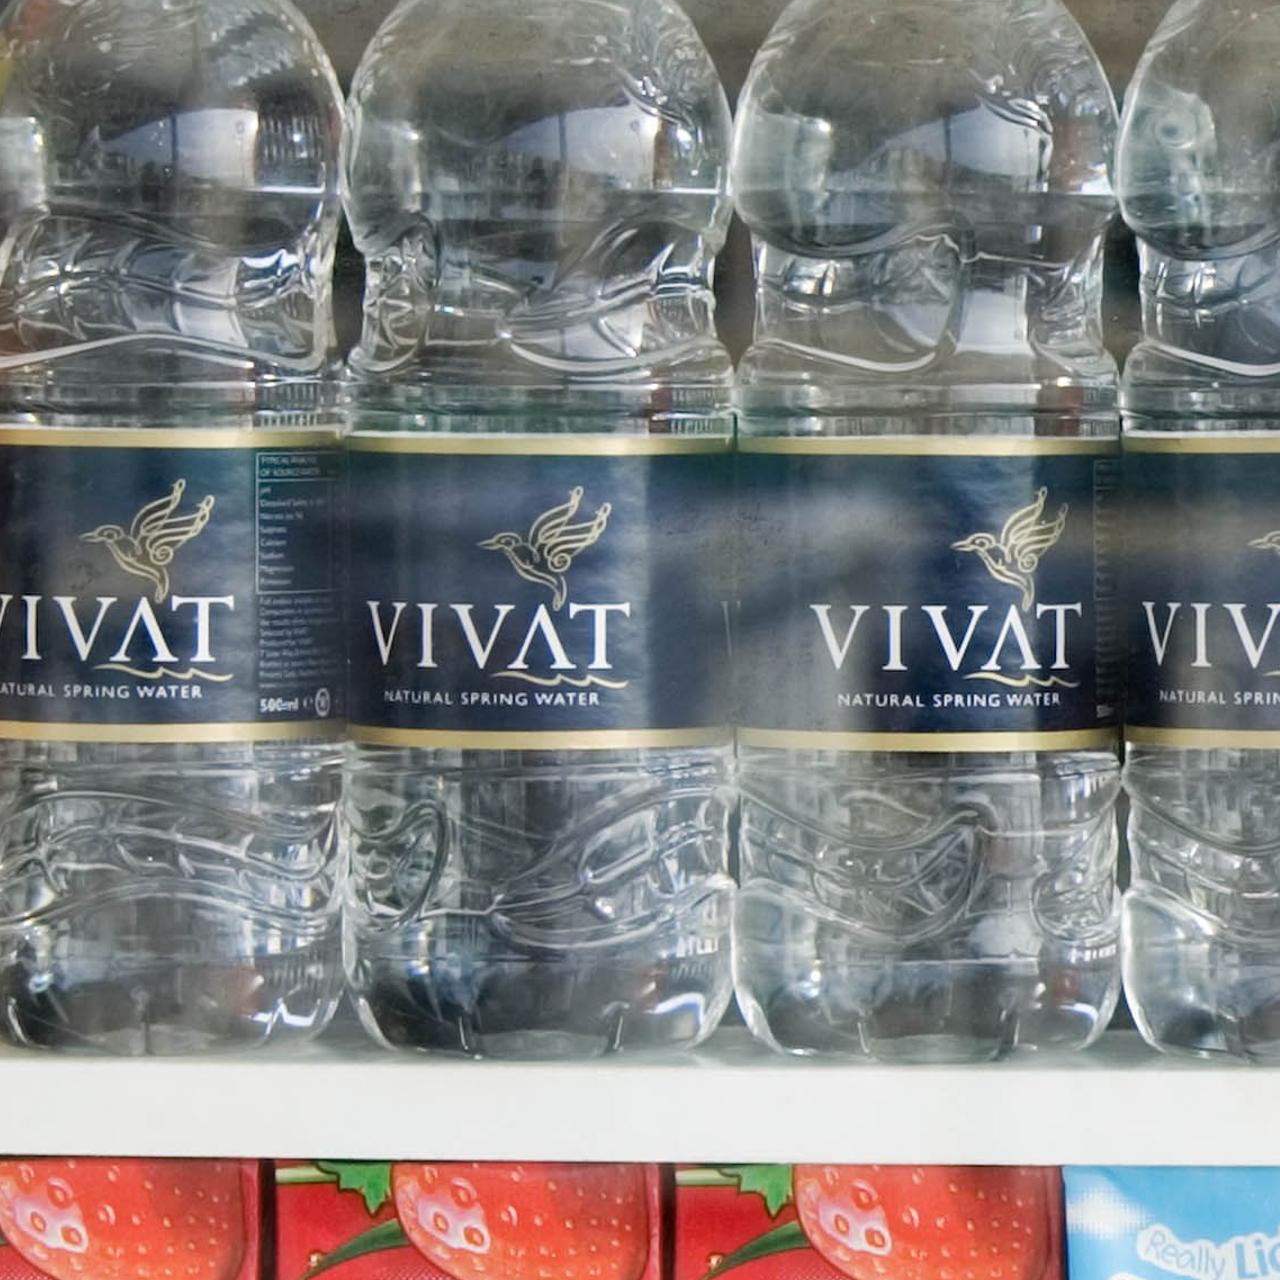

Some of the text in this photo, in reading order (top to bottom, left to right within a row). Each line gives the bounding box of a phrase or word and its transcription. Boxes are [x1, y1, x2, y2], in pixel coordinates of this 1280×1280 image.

[366, 601, 630, 671] VIVAT
[811, 602, 1082, 671] VIVAT
[385, 690, 599, 708] NATURAL SPRING WATER
[838, 693, 1061, 707] NATURAL SPRING WATER
[1160, 690, 1226, 706] NATURAL
